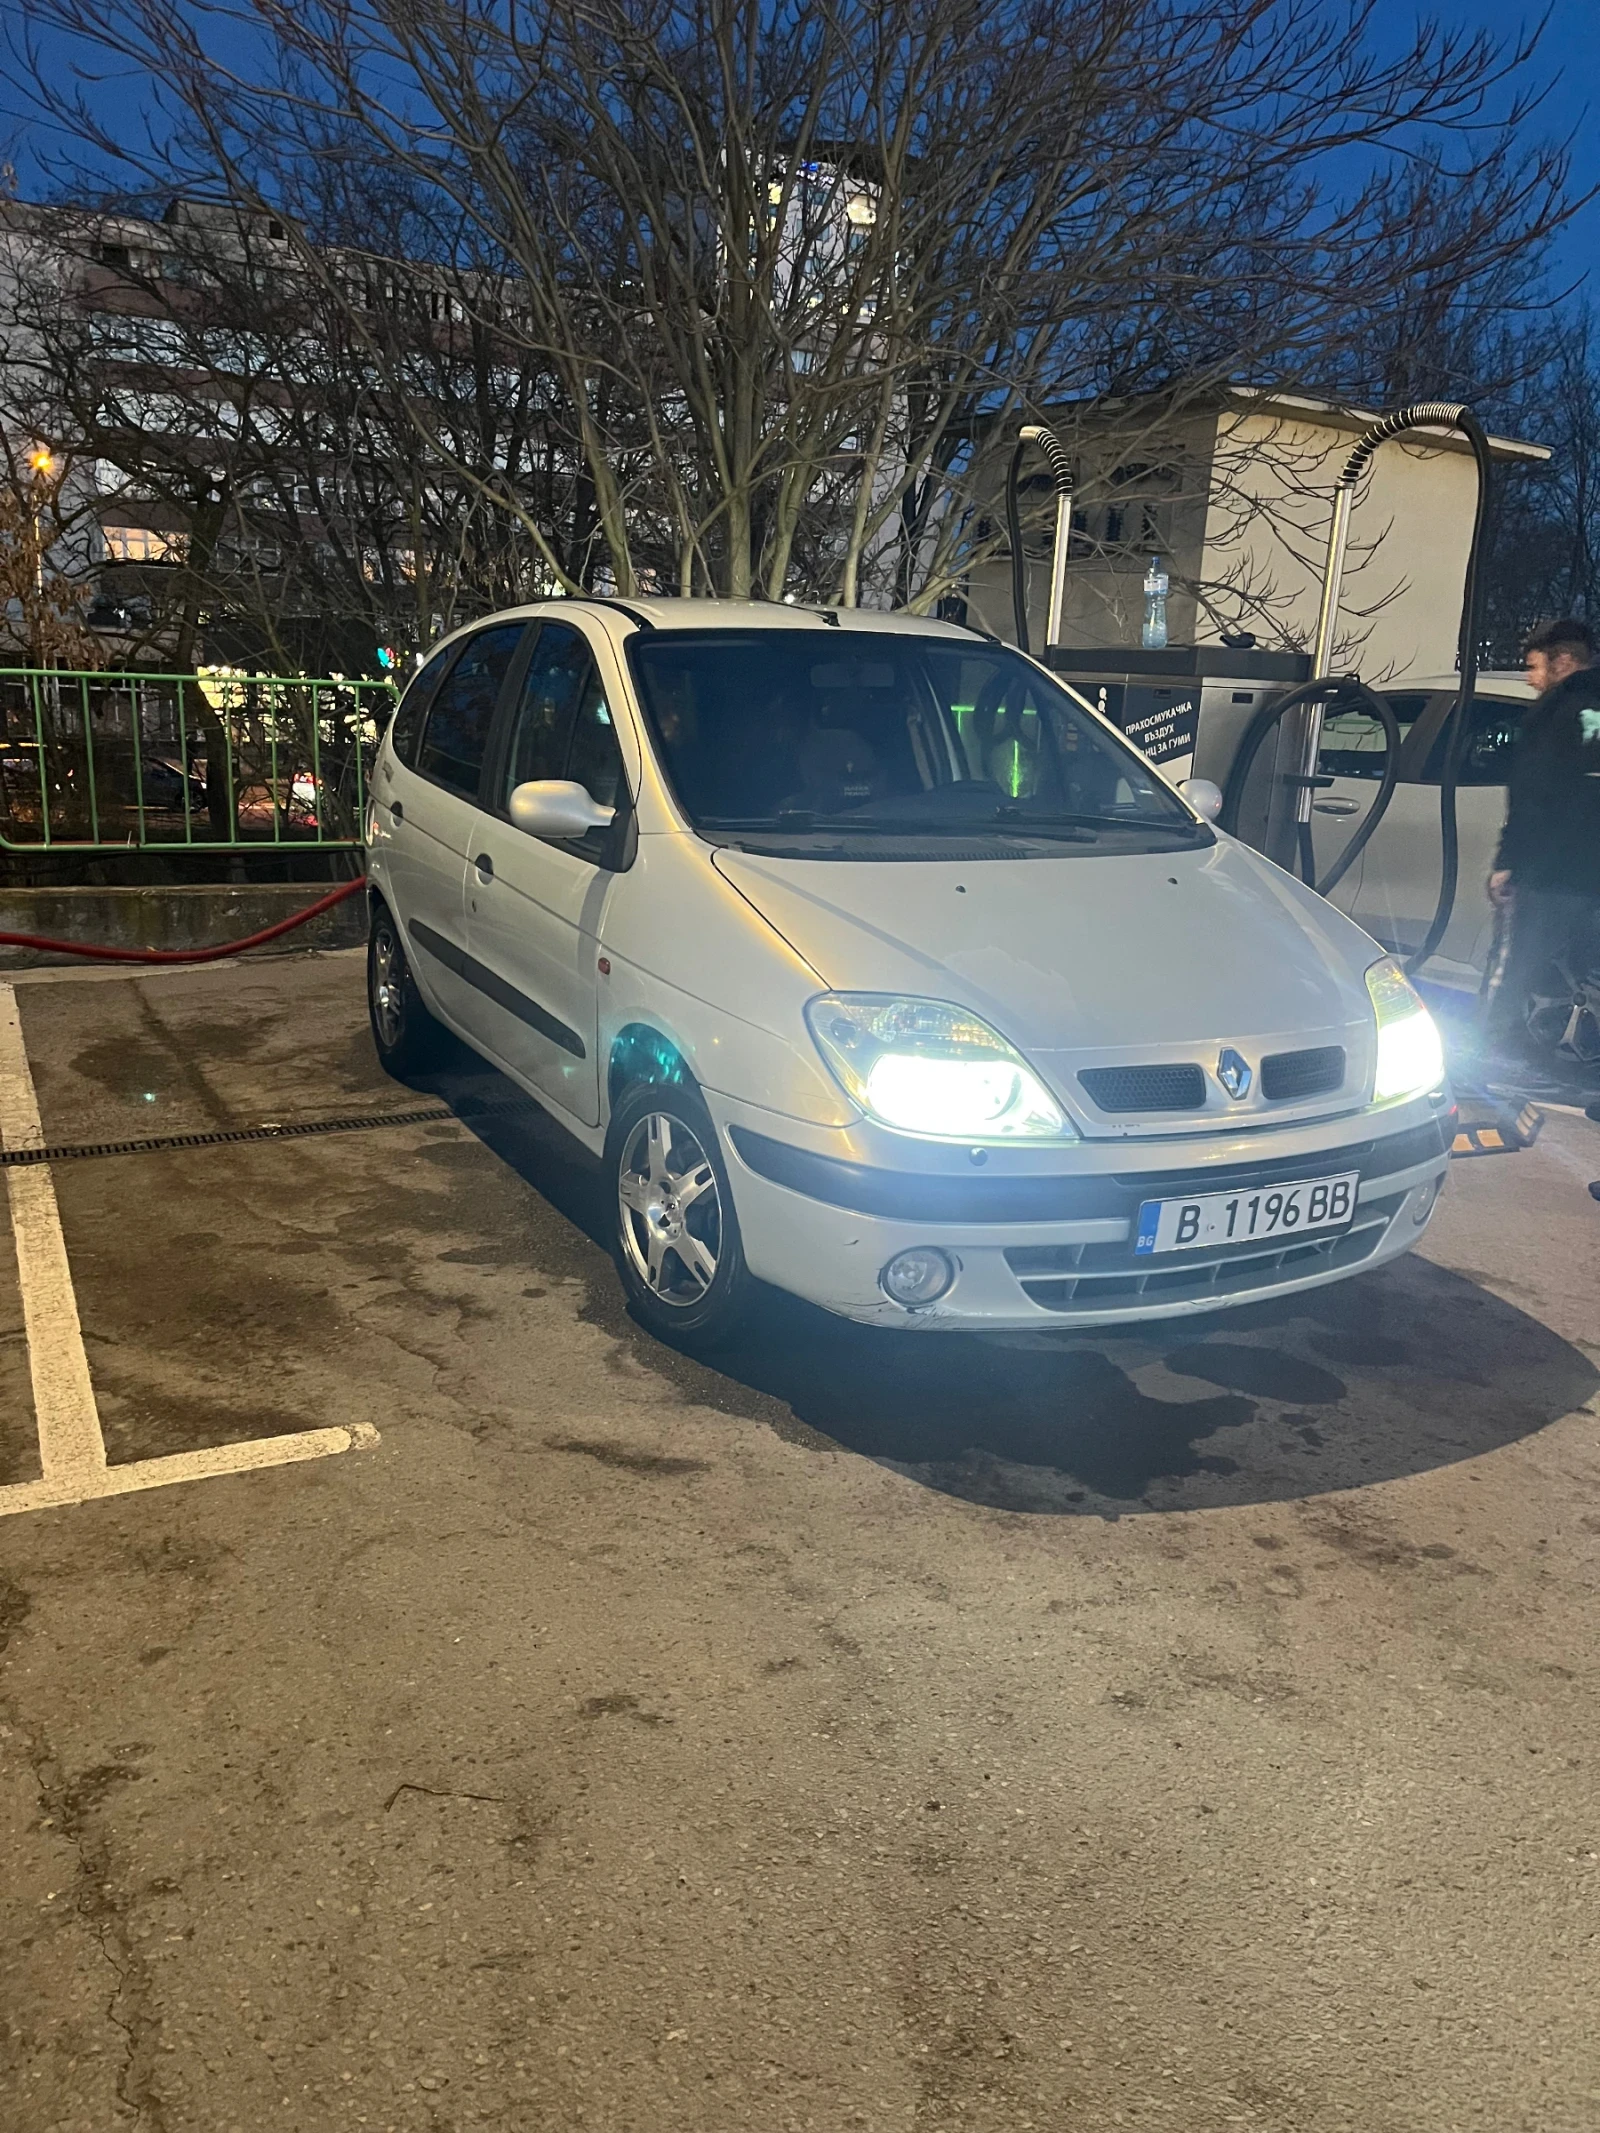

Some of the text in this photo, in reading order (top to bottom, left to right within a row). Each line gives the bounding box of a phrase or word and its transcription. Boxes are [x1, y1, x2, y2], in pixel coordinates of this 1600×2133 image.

[1125, 701, 1192, 735] ПРАХОСМУКАЧКА
[1144, 723, 1175, 743] ВЪЗДУХ
[1157, 742, 1168, 754] ЗА
[1169, 733, 1191, 749] ГУМИ
[1175, 1181, 1350, 1244] B 1196 BB
[1137, 1235, 1154, 1248] BG
